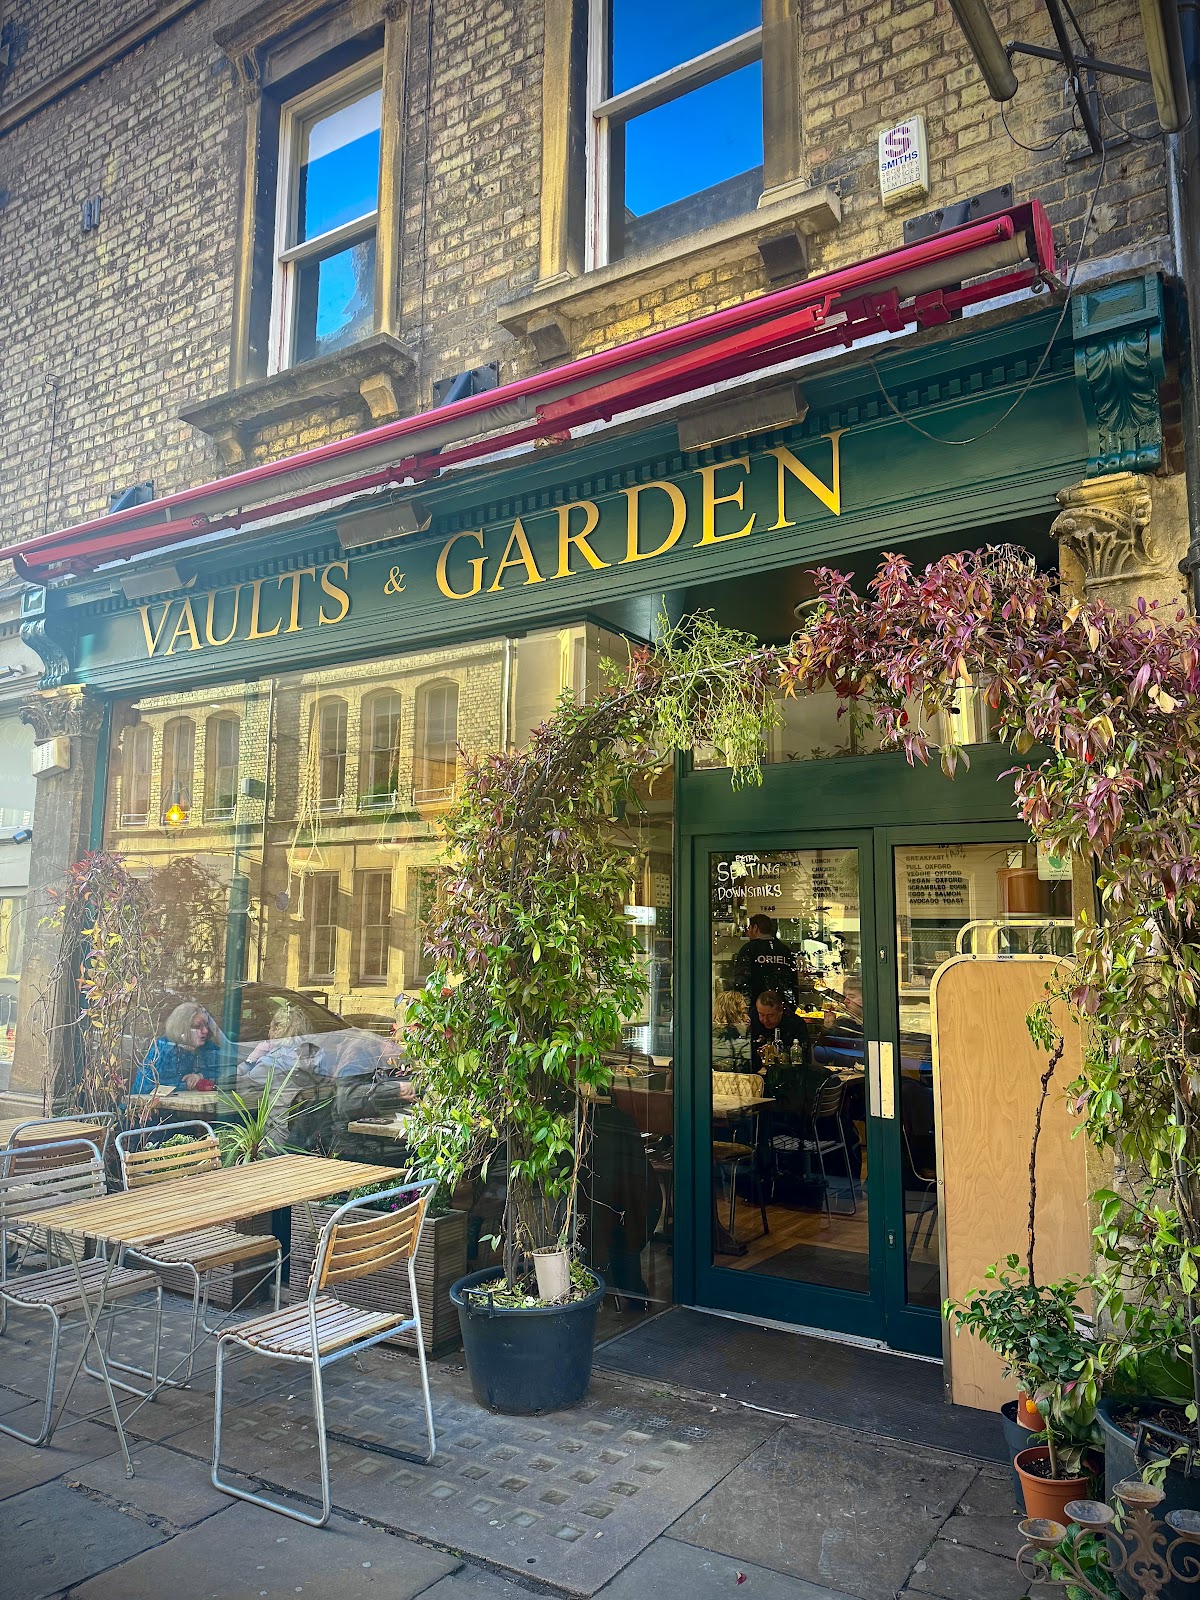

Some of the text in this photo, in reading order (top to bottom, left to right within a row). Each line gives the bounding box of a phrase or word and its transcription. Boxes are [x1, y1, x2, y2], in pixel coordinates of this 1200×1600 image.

[881, 150, 918, 172] SMITHS
[882, 160, 918, 178] SECURITY
[882, 166, 919, 184] SERVICES
[883, 173, 920, 190] LIMITED
[138, 427, 852, 659] VAULTS & GARDEN
[735, 854, 760, 862] EXTRA
[717, 861, 780, 885] SEATING
[718, 884, 782, 900] DOWNSTAIRS
[757, 955, 788, 965] ORIEL
